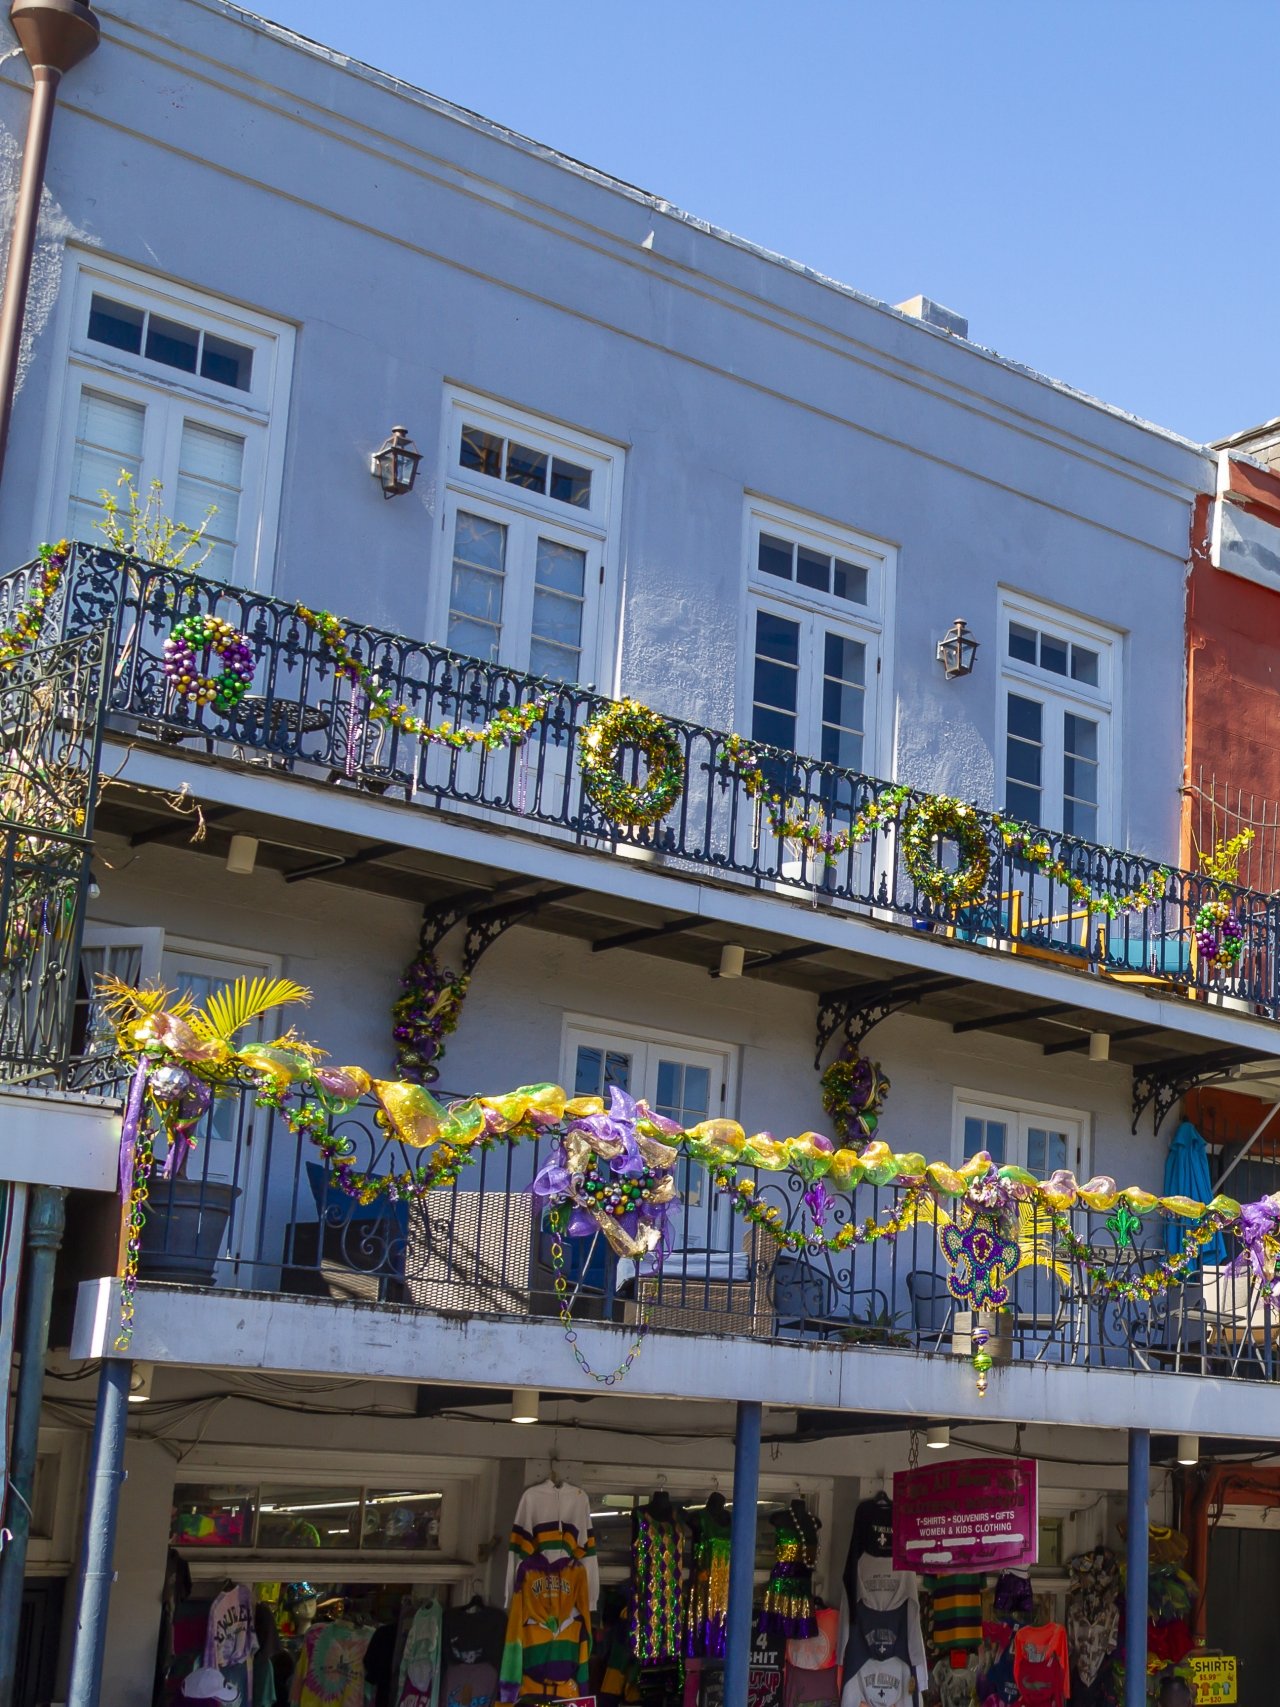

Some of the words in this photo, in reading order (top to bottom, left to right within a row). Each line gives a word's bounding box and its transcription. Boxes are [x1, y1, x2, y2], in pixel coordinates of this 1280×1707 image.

[916, 1515, 946, 1526] T-SHIRTS
[952, 1512, 989, 1523] SOUVENIRS
[995, 1510, 1015, 1521] GIFTS
[919, 1527, 946, 1537] WOMEN
[948, 1526, 953, 1535] &
[955, 1525, 972, 1534] KIDS
[975, 1522, 1012, 1533] CLOTHING
[756, 1632, 768, 1650] 4
